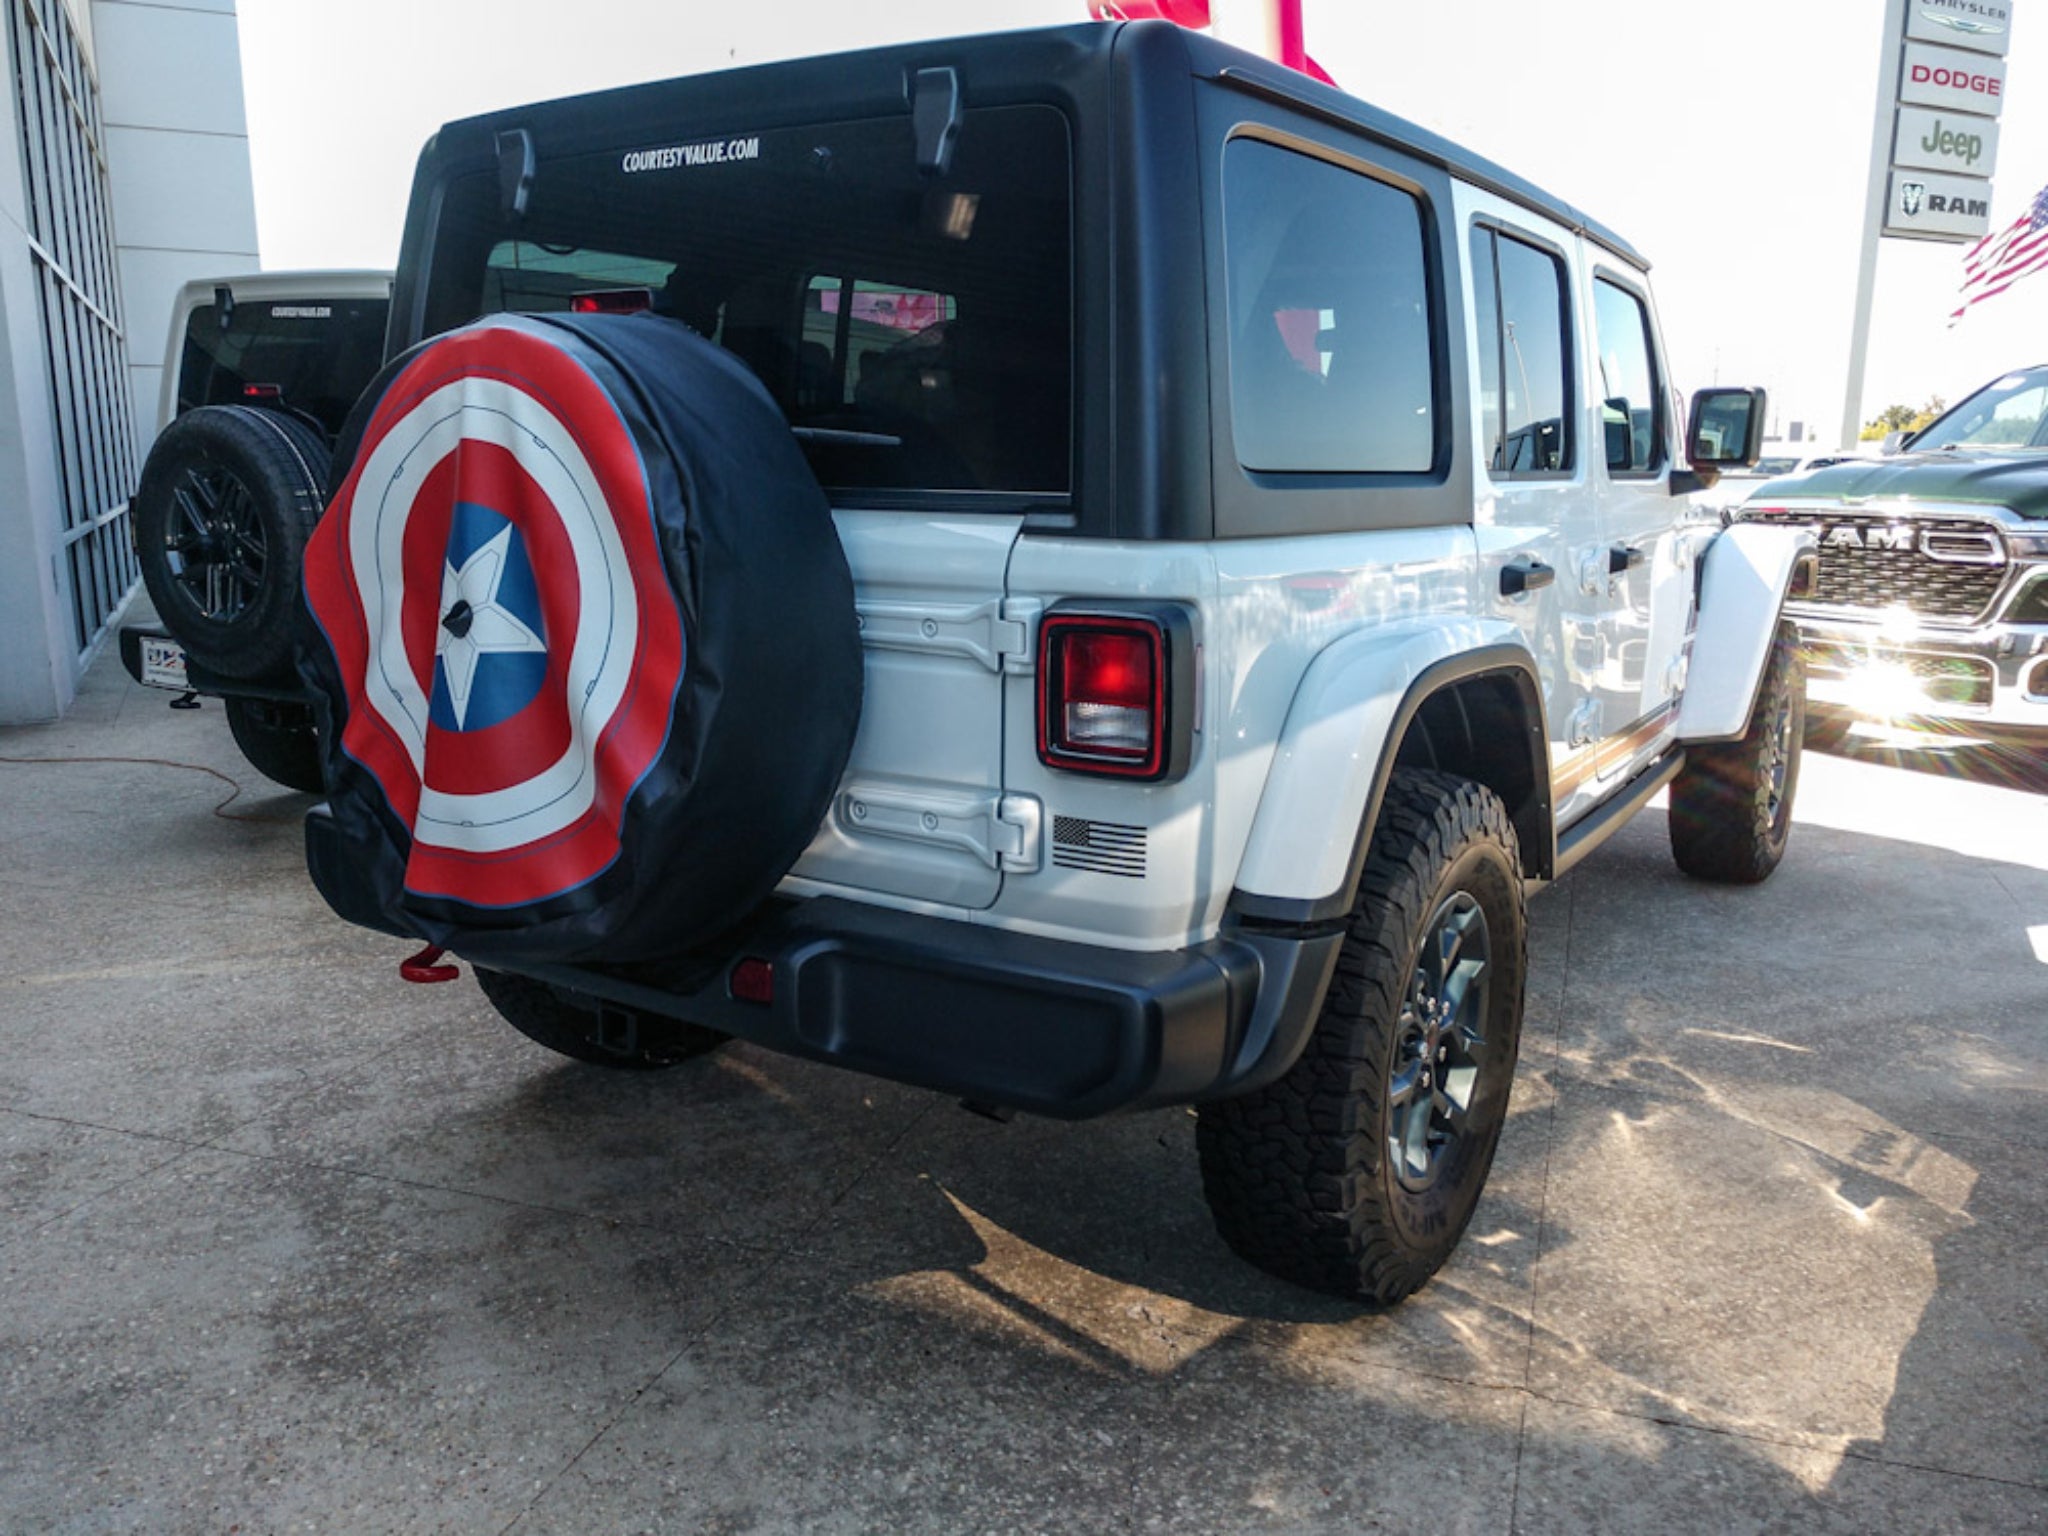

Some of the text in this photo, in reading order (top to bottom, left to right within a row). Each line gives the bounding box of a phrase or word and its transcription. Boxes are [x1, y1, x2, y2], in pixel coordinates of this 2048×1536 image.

[1911, 65, 2000, 97] DODGE
[622, 137, 759, 173] COURTESYVALUE.COM
[1921, 119, 1982, 165] Jeep
[1928, 194, 1988, 218] RAM
[1822, 526, 1915, 551] AM
